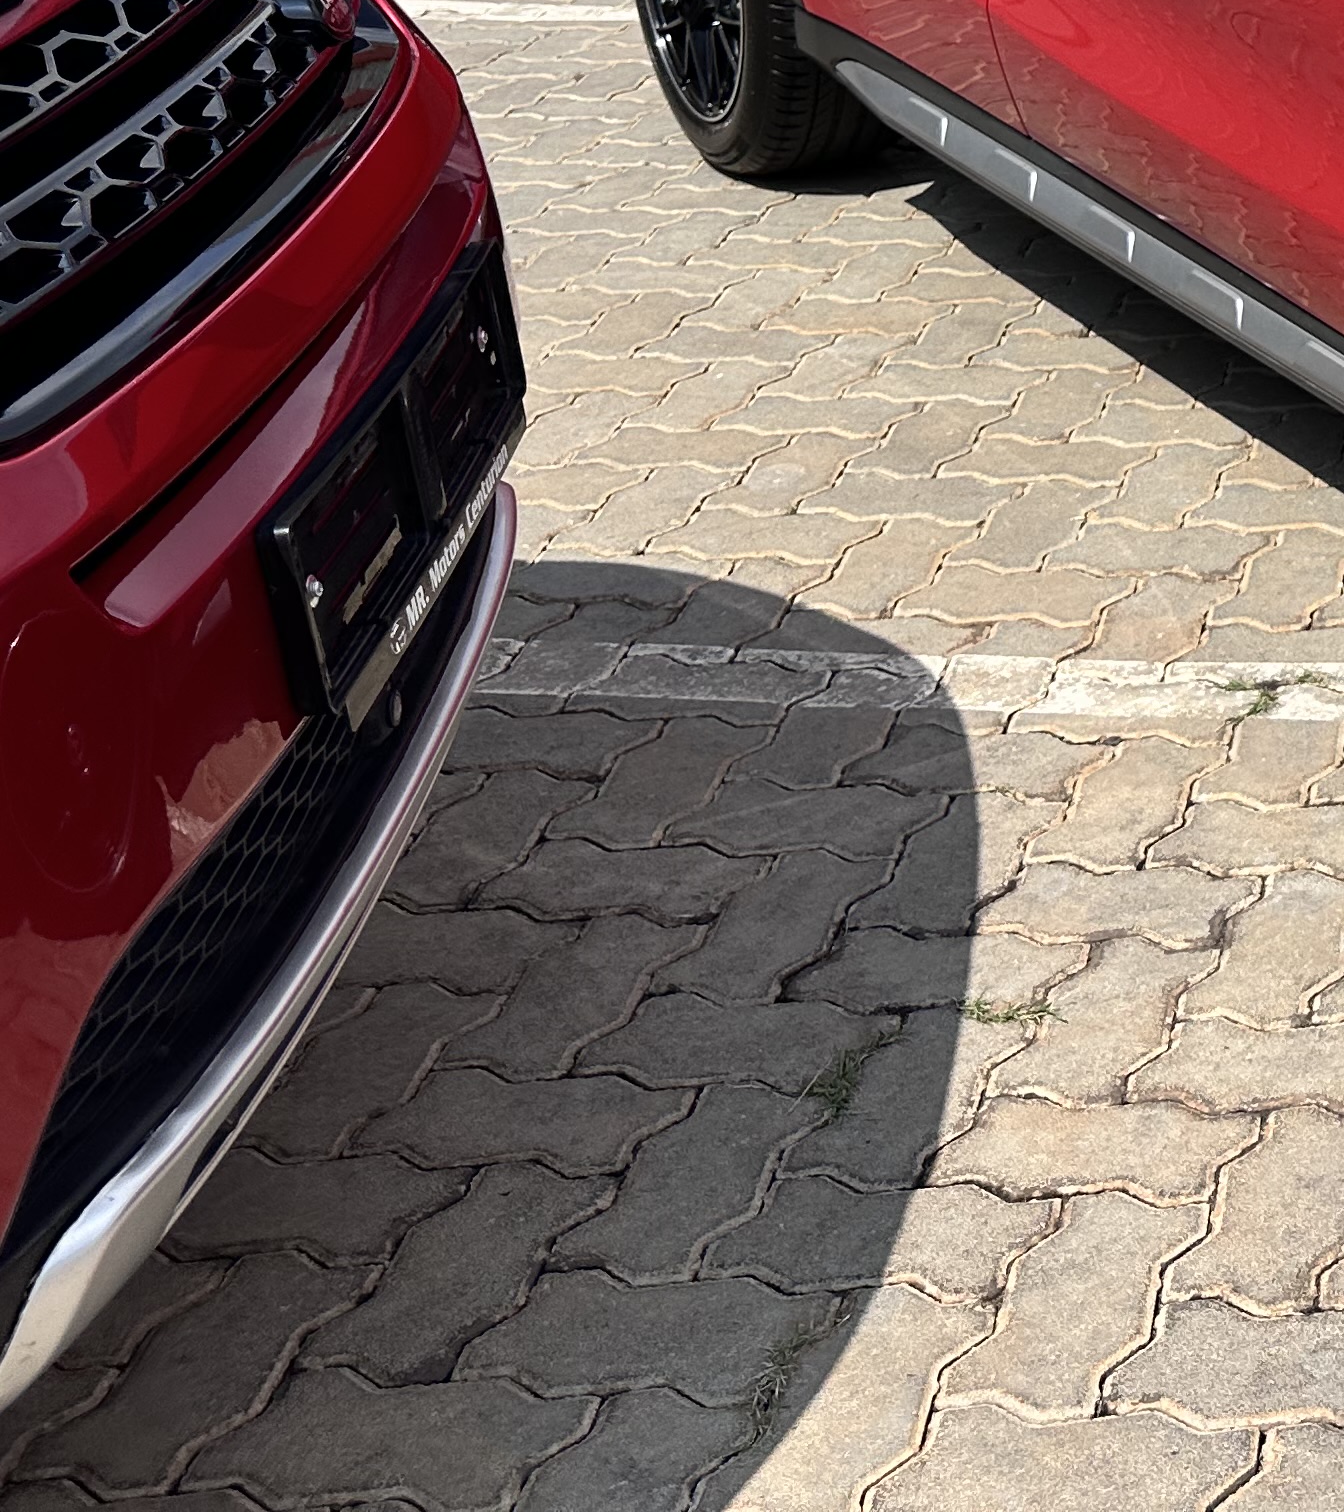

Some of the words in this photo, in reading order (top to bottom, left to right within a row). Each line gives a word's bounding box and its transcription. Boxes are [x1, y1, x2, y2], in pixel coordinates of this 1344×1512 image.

[405, 584, 430, 630] MR.
[428, 523, 466, 592] Motors
[465, 444, 509, 529] Centurion
